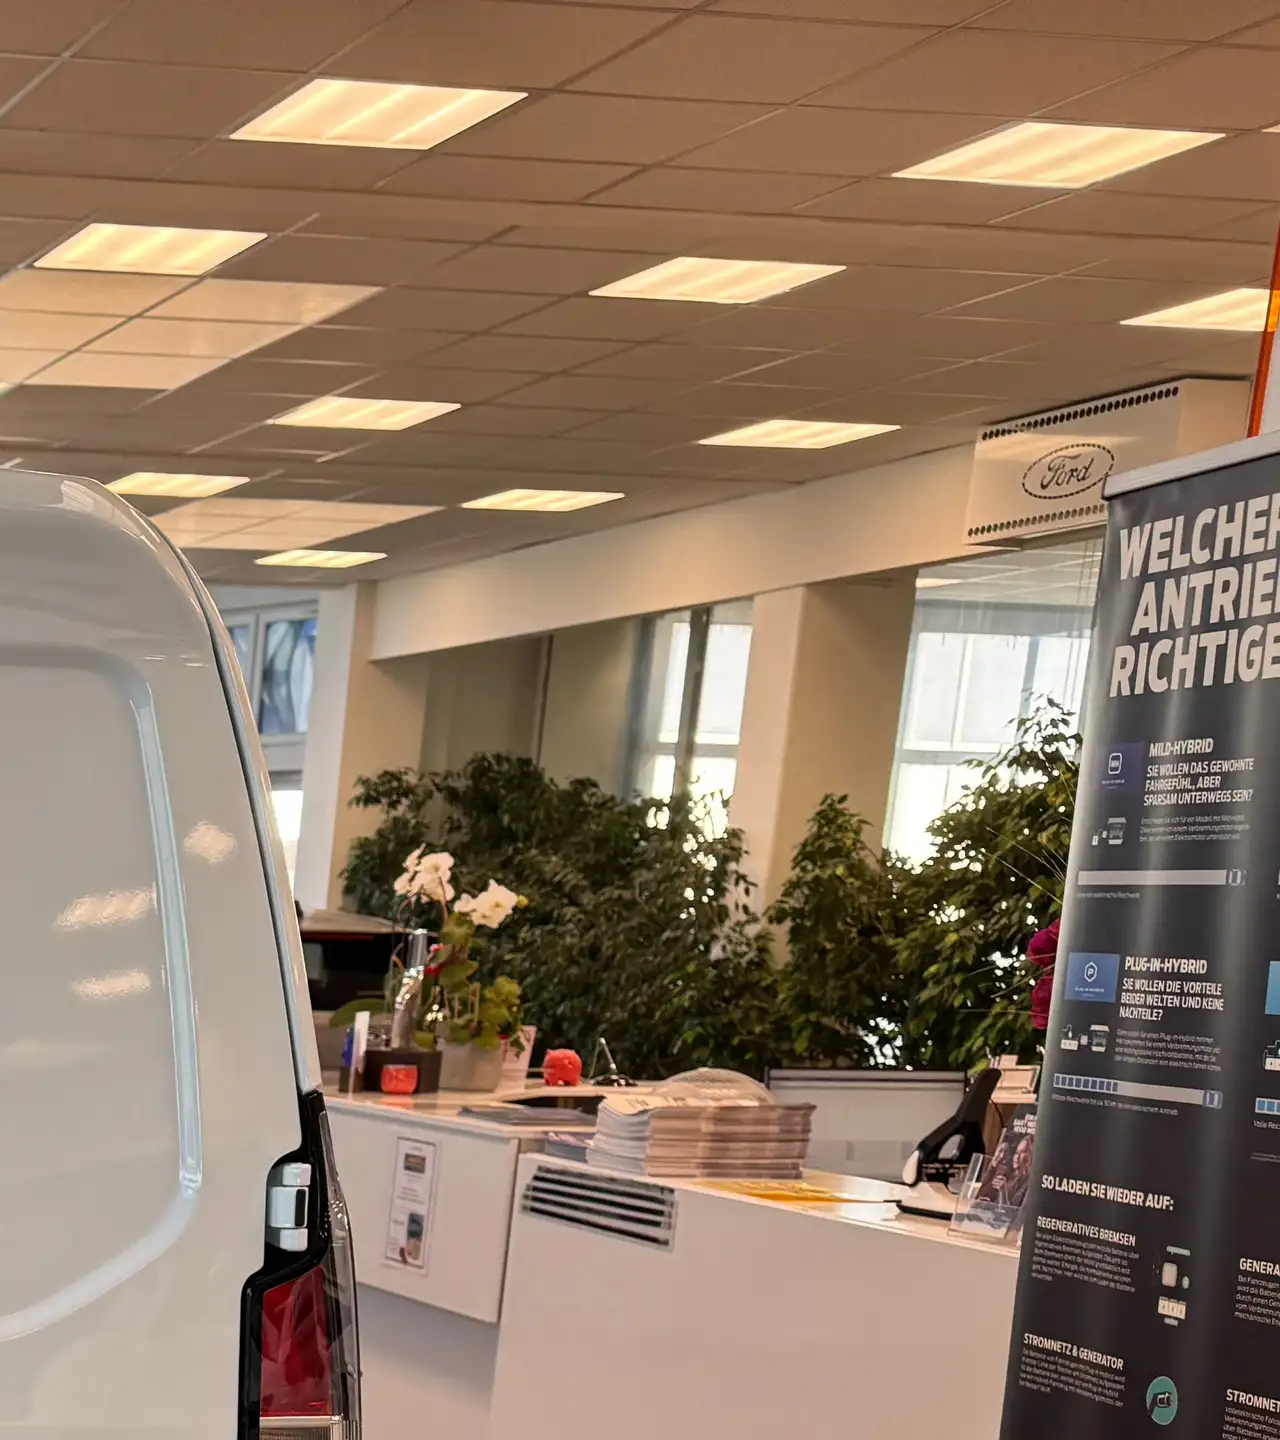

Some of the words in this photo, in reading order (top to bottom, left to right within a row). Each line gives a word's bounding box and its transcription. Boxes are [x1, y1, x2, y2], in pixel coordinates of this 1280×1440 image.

[1130, 557, 1280, 636] ANTRIE
[1149, 738, 1214, 757] MILD-HYBRID
[1146, 765, 1159, 778] SIE
[1159, 762, 1189, 776] WOLLEN
[1190, 761, 1209, 774] DAS
[1209, 758, 1255, 773] GEWOHNTE
[1144, 775, 1195, 791] FAHRGEFÜHL,
[1196, 775, 1222, 789] ABER
[1143, 793, 1178, 806] SPARSAM
[1178, 790, 1232, 804] UNTERWEGS
[1232, 789, 1254, 802] SEIN?
[1125, 956, 1208, 975] PLUG-IN-HYBRID
[1122, 977, 1134, 991] SIE
[1134, 979, 1165, 993] WOLLEN
[1166, 980, 1182, 993] DIE
[1182, 981, 1223, 996] VORTEILE
[1120, 992, 1146, 1006] BEIDER
[1146, 994, 1181, 1008] WELTEN
[1181, 995, 1202, 1009] UND
[1202, 997, 1225, 1011] KEINE
[1119, 1006, 1163, 1021] NACHTEILE?
[1041, 1175, 1055, 1189] SO
[1055, 1177, 1090, 1196] LADEN
[1090, 1182, 1105, 1199] SIE
[1106, 1185, 1144, 1206] WIEDER
[1145, 1193, 1174, 1211] AUF:
[1036, 1215, 1099, 1239] REGENERATIVES
[1099, 1228, 1136, 1246] BREMSEN
[1024, 1333, 1072, 1355] STROMNETZ
[1079, 1347, 1124, 1370] GENERATOR
